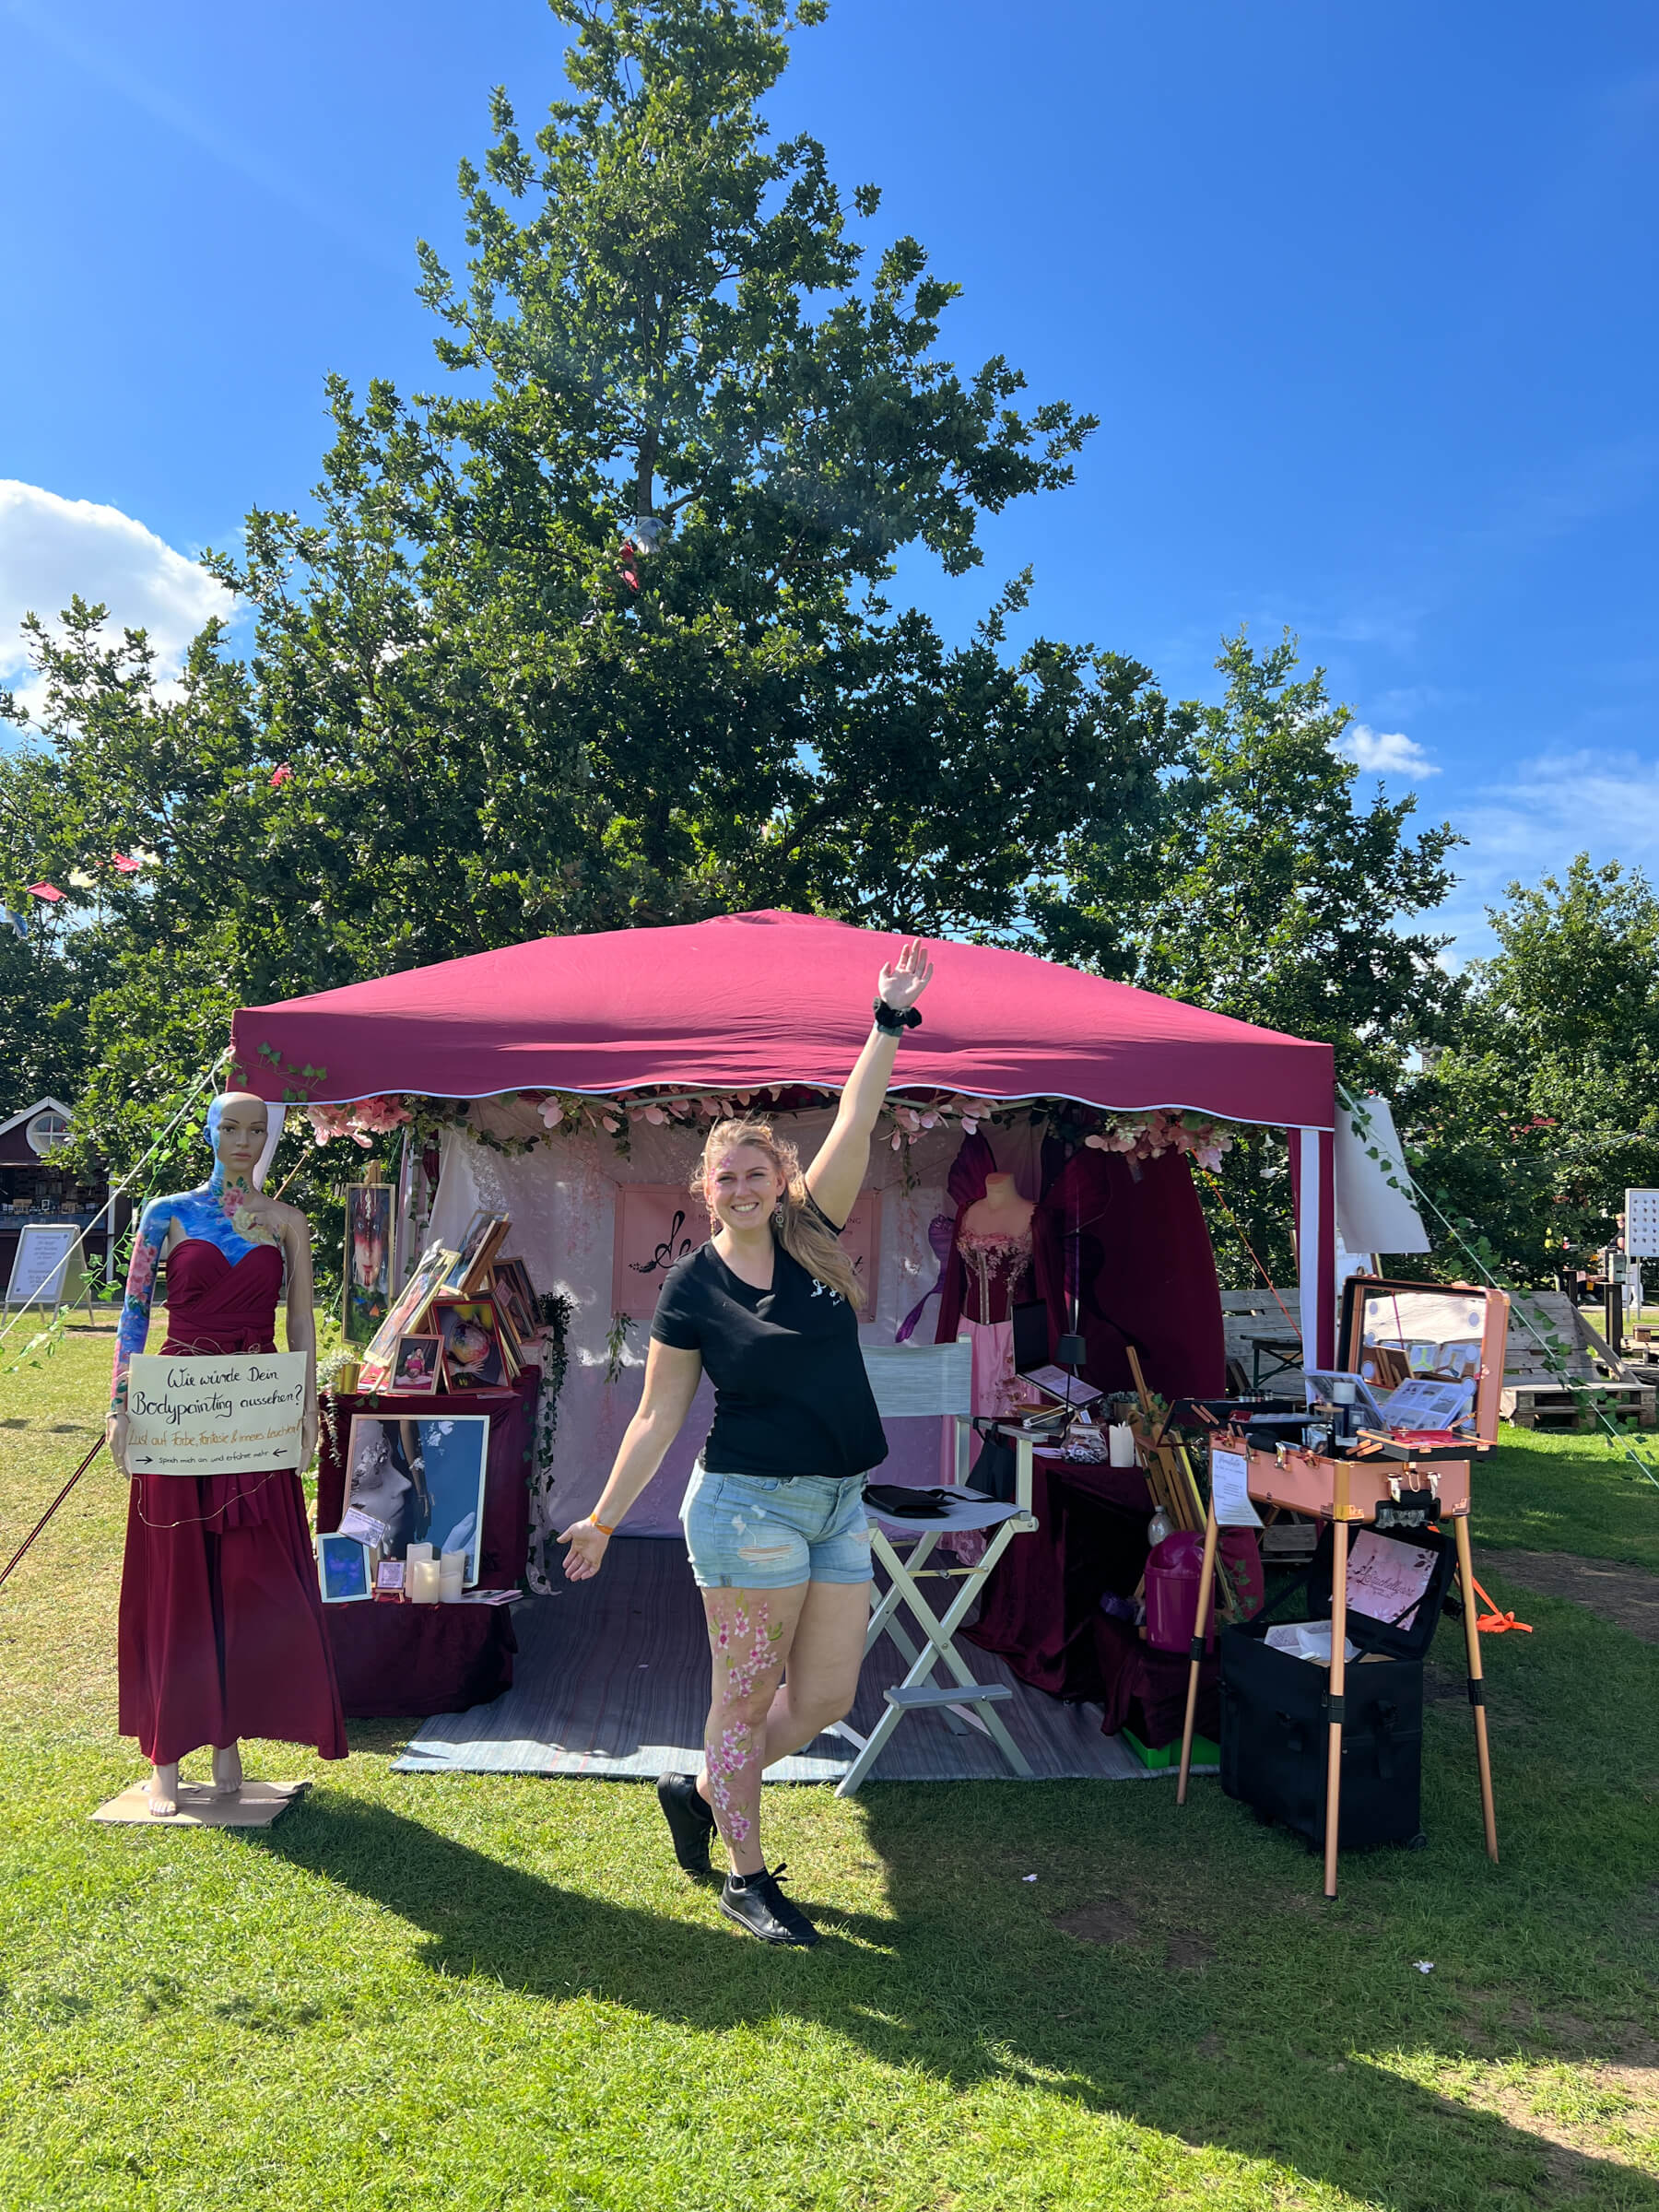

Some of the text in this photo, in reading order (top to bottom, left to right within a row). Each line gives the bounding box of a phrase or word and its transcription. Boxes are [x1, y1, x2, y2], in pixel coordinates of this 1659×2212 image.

[167, 1366, 279, 1388] Wie würde Dein
[131, 1384, 303, 1426] Bodypainting aussehen?
[127, 1430, 148, 1446] Lust
[150, 1430, 167, 1446] auf
